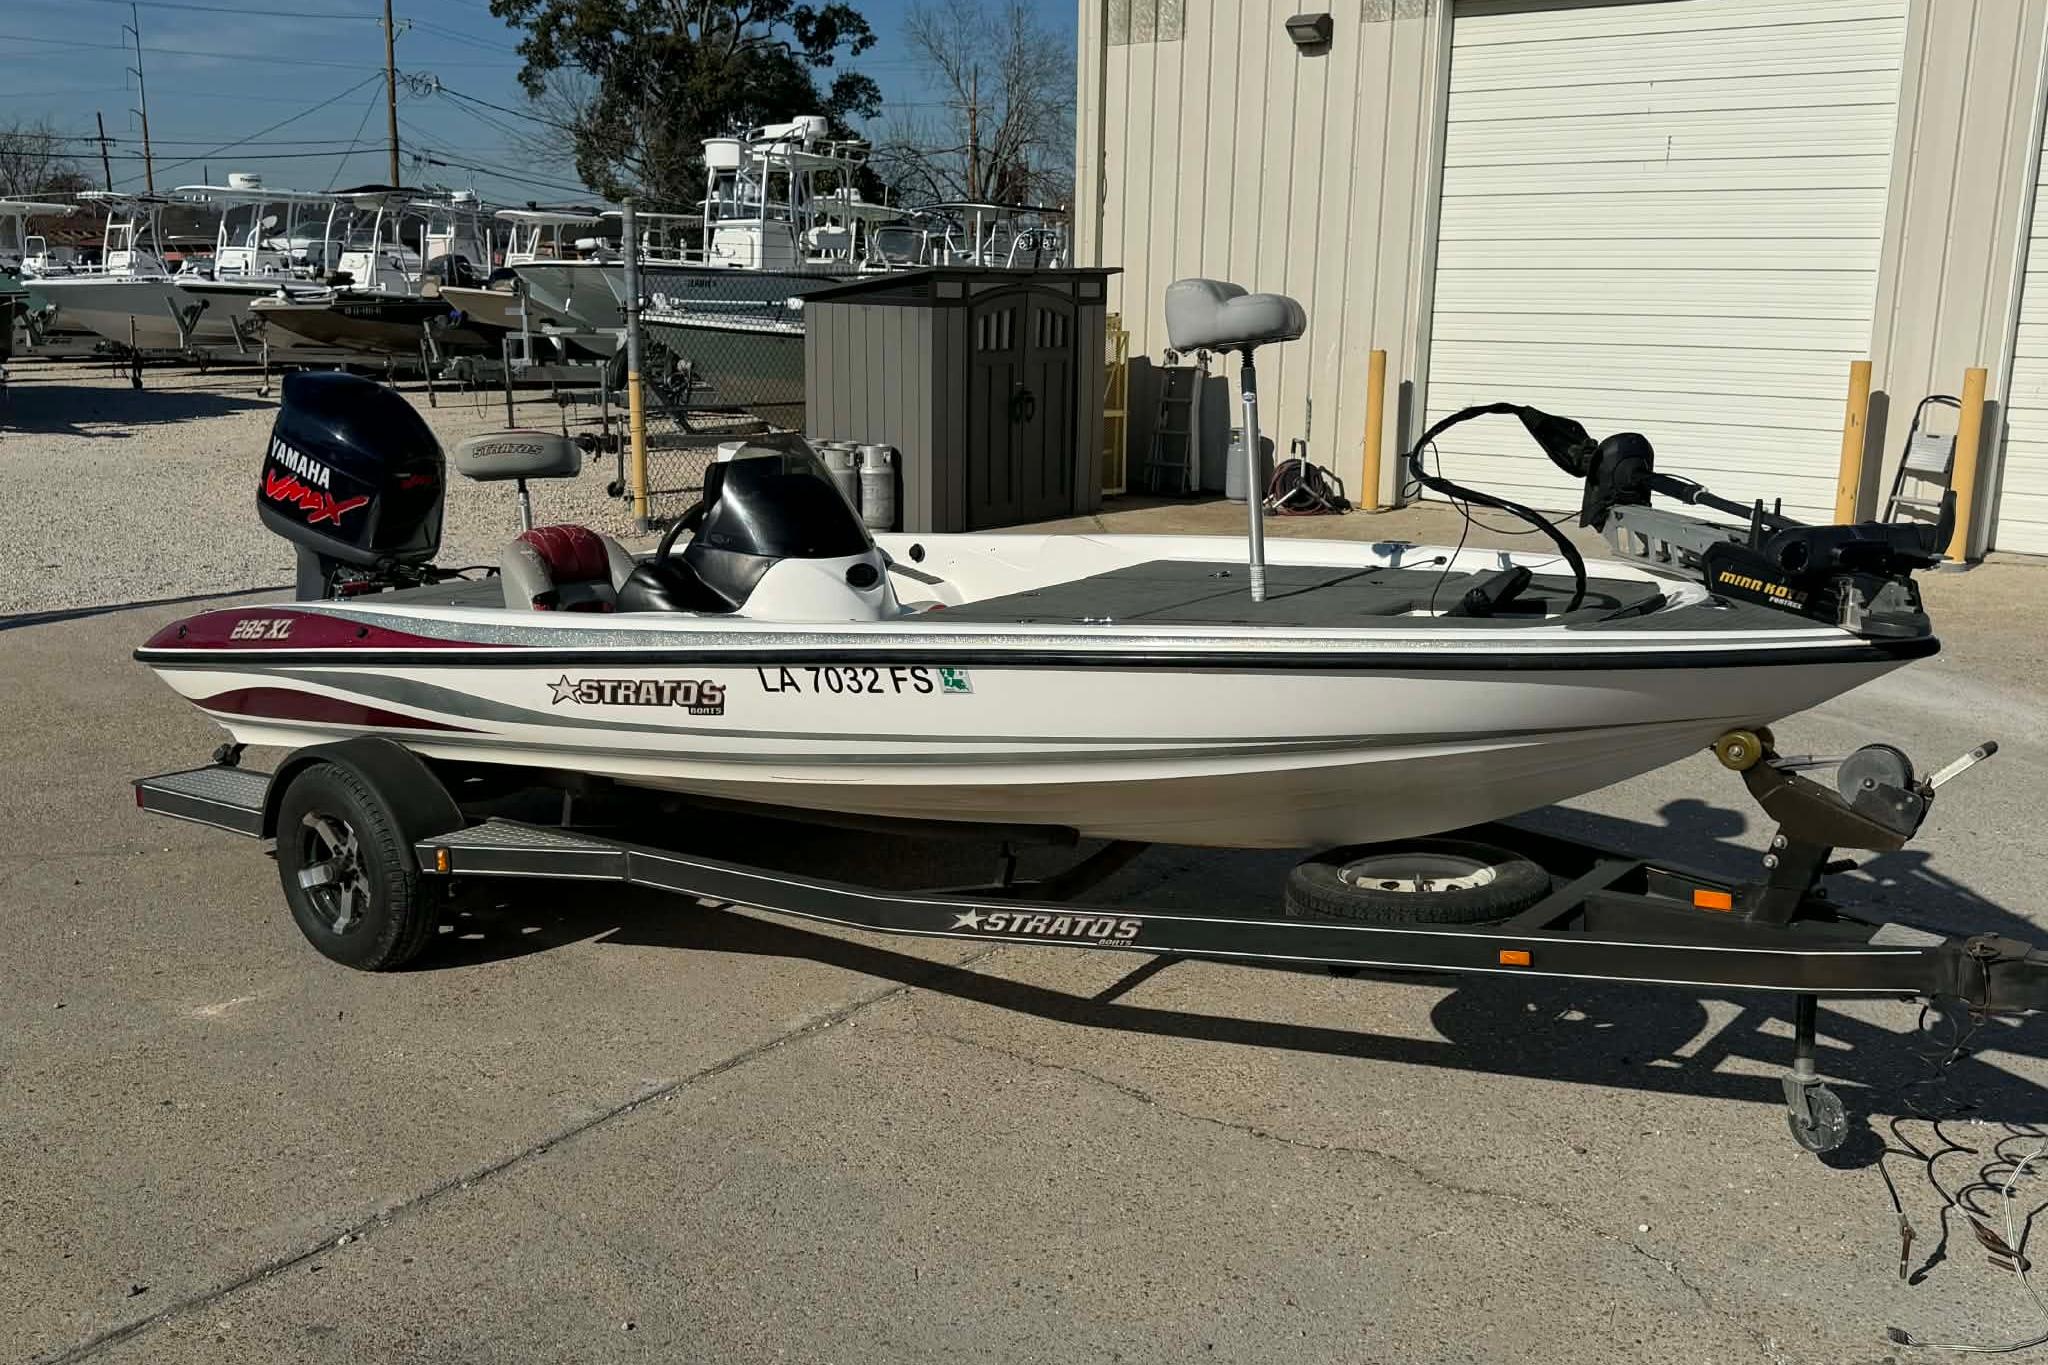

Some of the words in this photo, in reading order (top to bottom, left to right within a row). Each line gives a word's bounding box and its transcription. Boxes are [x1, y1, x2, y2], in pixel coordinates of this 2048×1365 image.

[271, 435, 330, 490] YAMAHA
[472, 442, 545, 459] STRATOS
[229, 618, 270, 639] 285
[263, 618, 295, 639] XL
[578, 679, 726, 707] STRATOS
[756, 667, 801, 693] LA
[804, 667, 885, 693] 7032
[889, 667, 934, 693] FS
[689, 706, 724, 715] BOATS
[983, 912, 1144, 939] STRATOS
